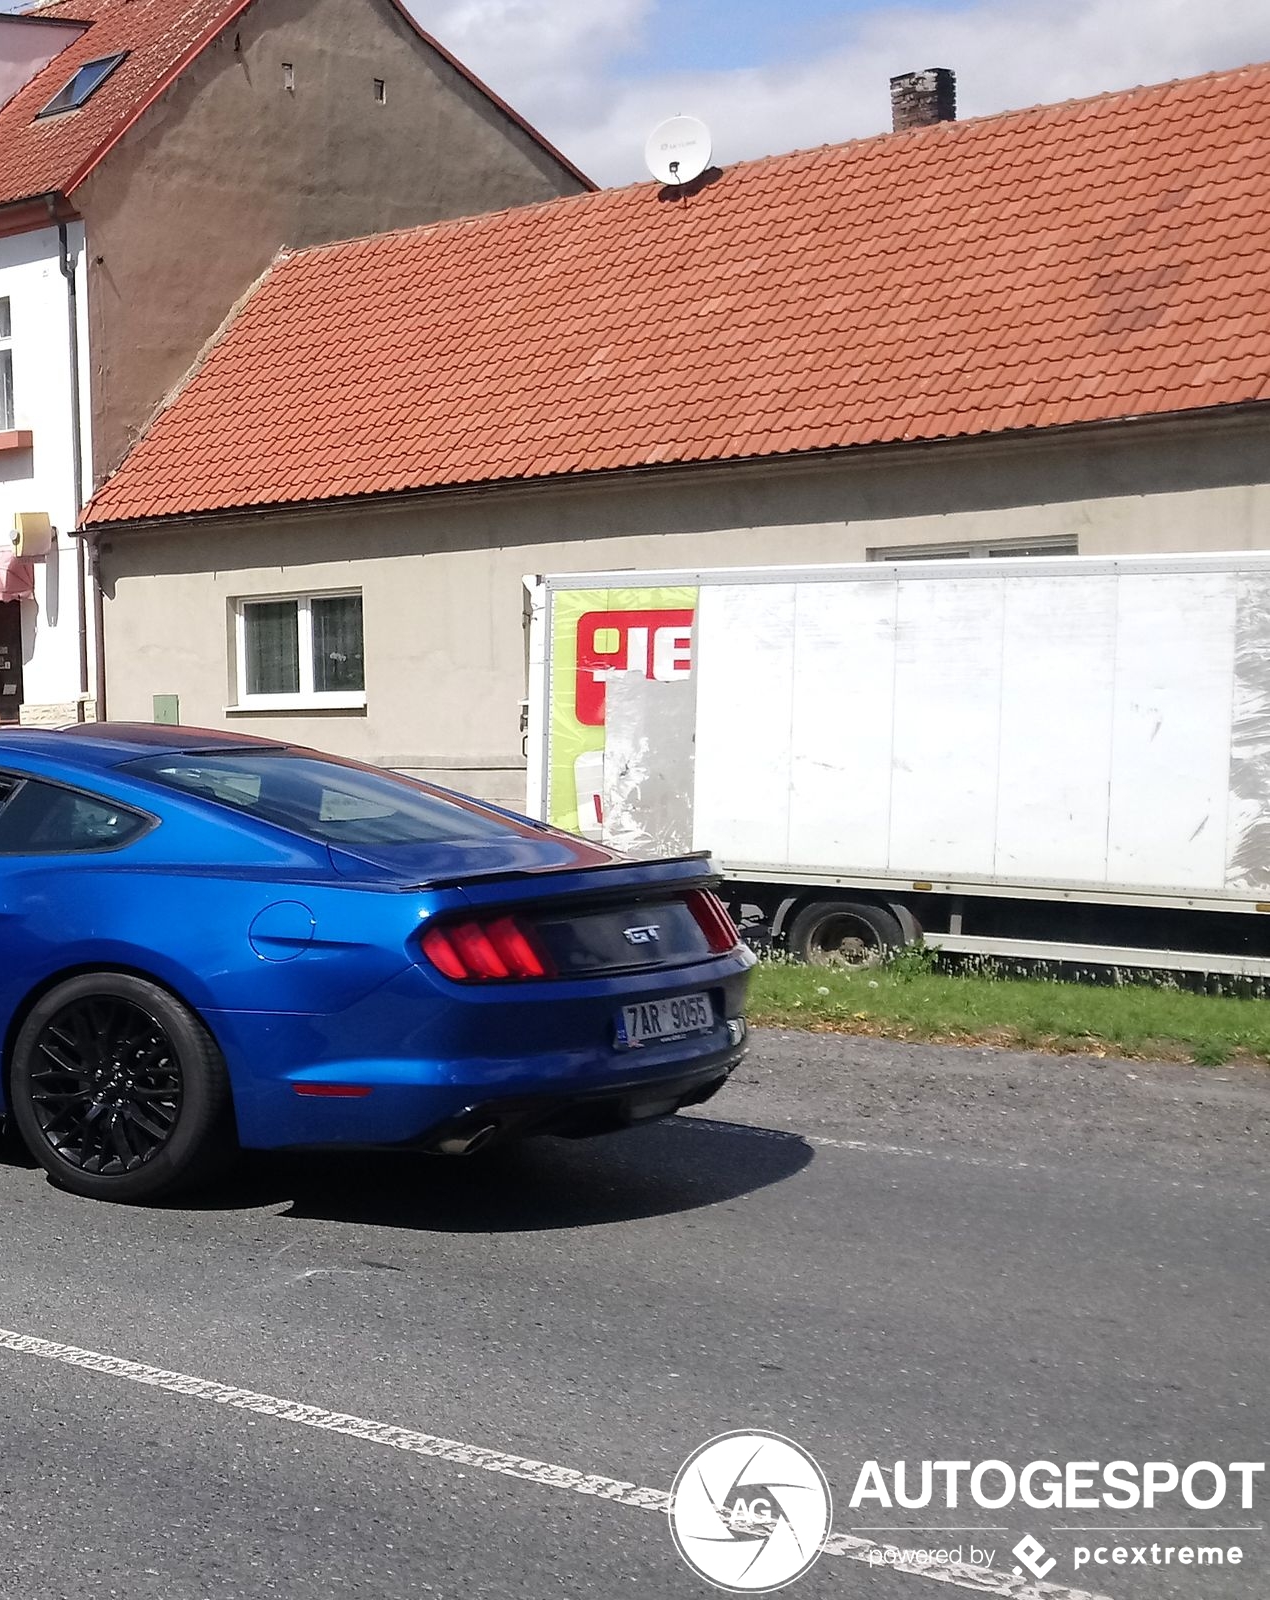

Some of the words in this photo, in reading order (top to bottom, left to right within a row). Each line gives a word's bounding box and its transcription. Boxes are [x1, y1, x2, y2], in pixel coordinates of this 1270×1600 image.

[623, 925, 660, 944] GT
[627, 1004, 662, 1037] 7AR
[671, 997, 707, 1029] 9055
